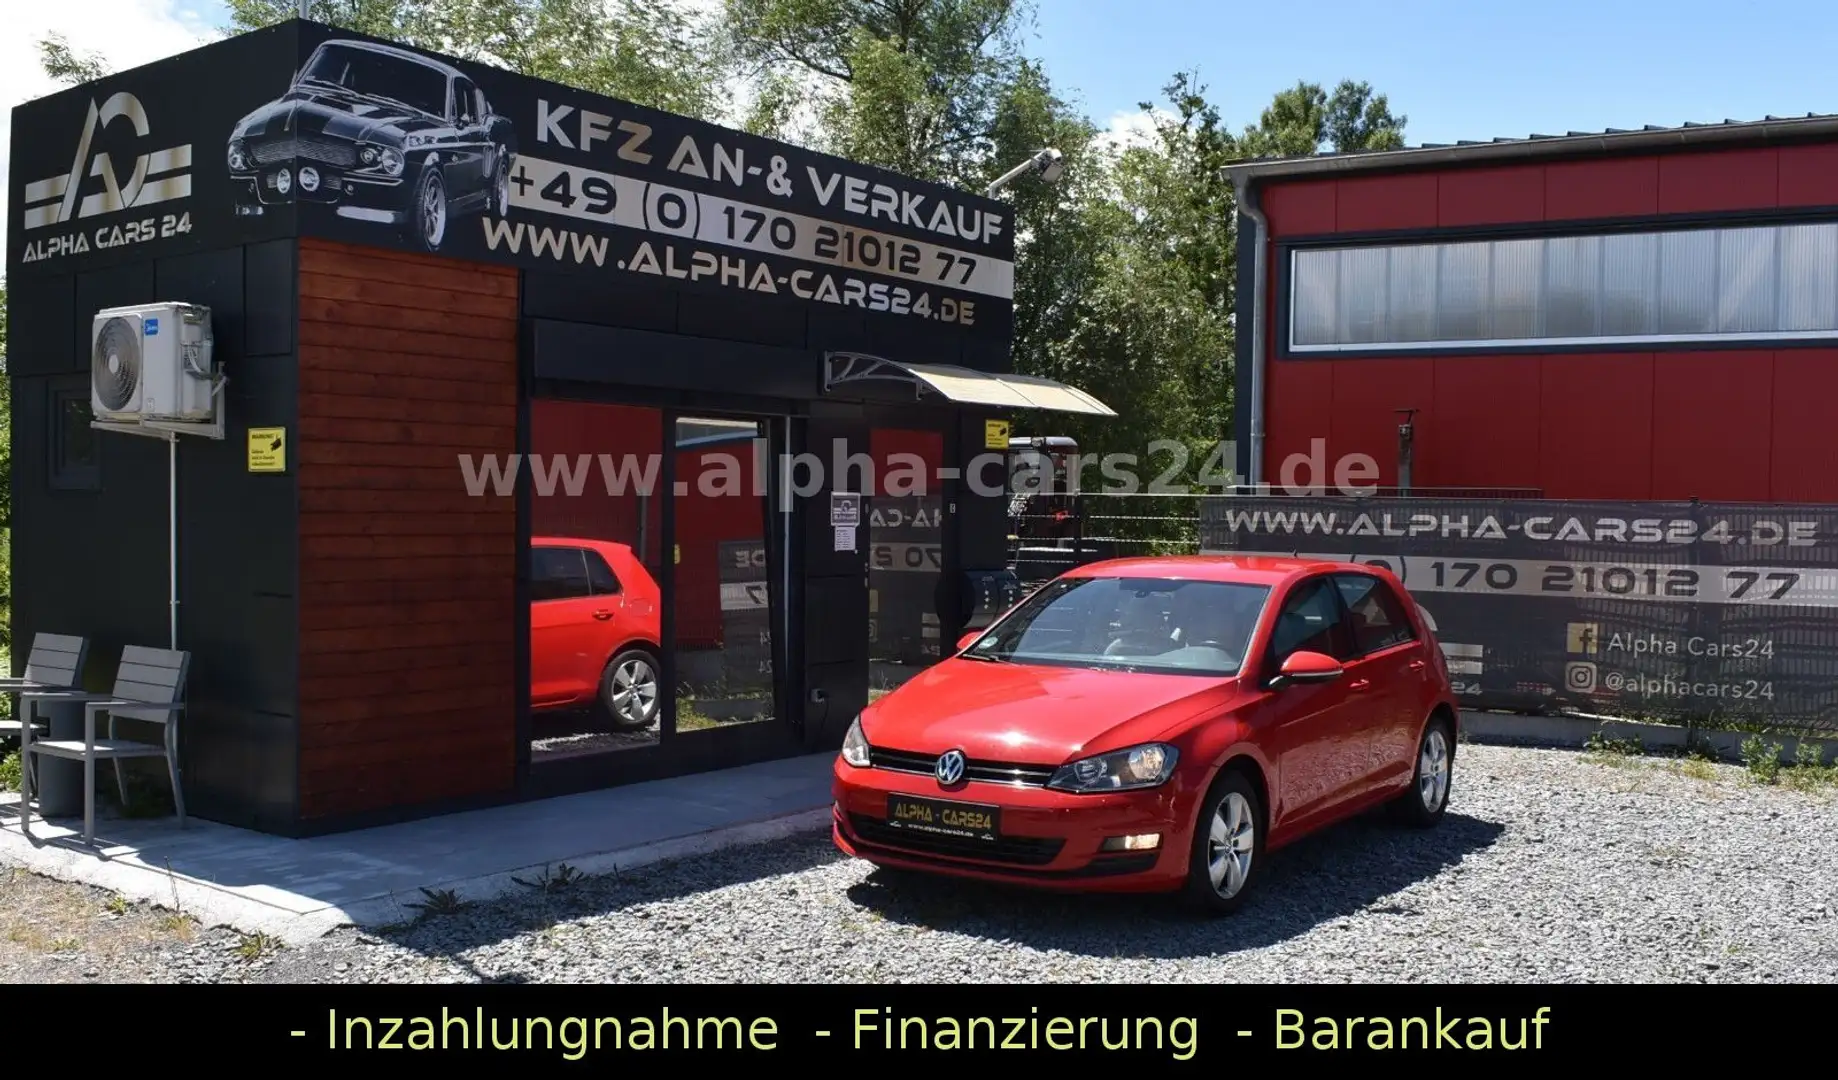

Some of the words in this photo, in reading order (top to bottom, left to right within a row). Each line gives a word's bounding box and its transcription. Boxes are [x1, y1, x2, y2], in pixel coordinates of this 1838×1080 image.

[536, 98, 653, 165] KFZ
[806, 165, 1003, 245] VERKAUF
[22, 232, 90, 263] ALPHA
[94, 217, 156, 249] CARS
[161, 211, 193, 239] 24
[510, 164, 617, 215] +49
[642, 181, 700, 240] (0)
[722, 205, 797, 251] 170
[814, 224, 922, 277] 21012
[935, 251, 978, 286] 77
[1224, 508, 1819, 547] WWW.ALPHA-CARS24.DE
[1430, 560, 1518, 591] 170
[1541, 565, 1700, 597] 21012
[1725, 570, 1800, 601] 77
[1607, 632, 1677, 659] Alpha
[1687, 636, 1775, 659] Cars24
[1604, 672, 1775, 700] @alphacars24
[894, 802, 933, 822] ALPHA
[942, 808, 993, 829] CARS24
